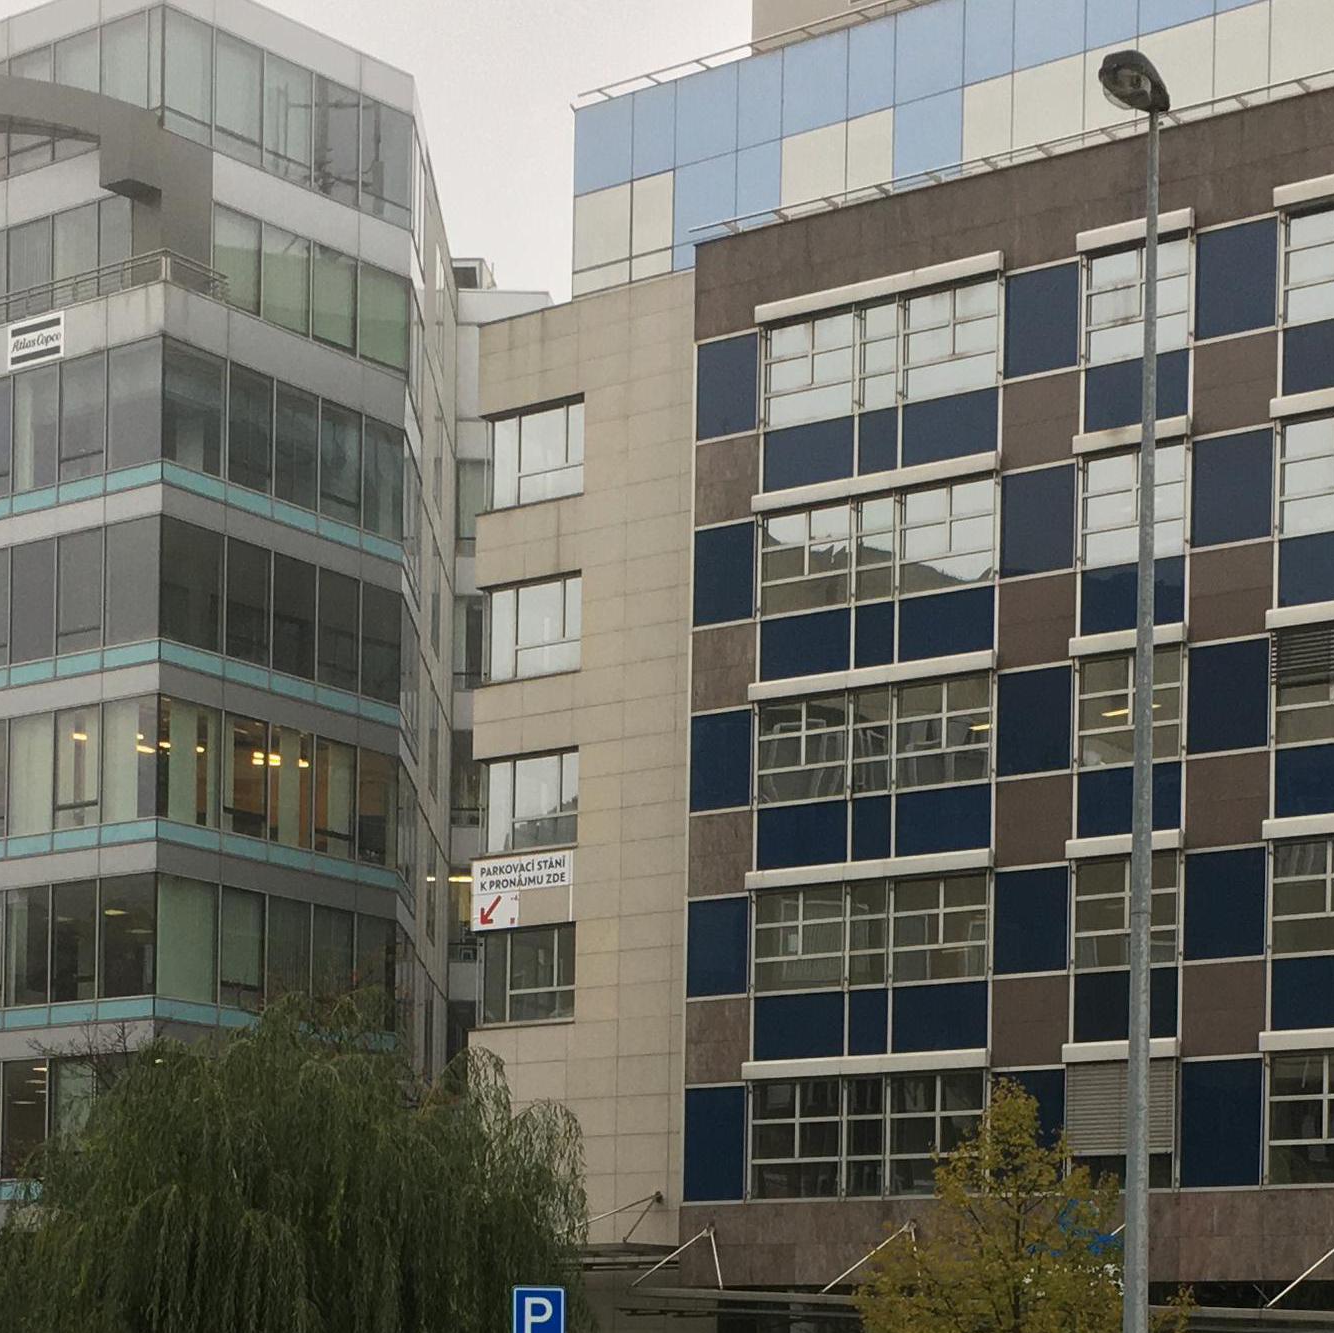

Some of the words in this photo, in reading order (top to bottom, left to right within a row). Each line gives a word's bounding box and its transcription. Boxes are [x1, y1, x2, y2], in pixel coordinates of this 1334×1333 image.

[12, 338, 36, 352] Atlas
[37, 332, 61, 346] Copco
[480, 859, 534, 877] PARKOVACÍ
[537, 855, 566, 871] STÁNÍ
[480, 881, 487, 891] K
[489, 874, 543, 890] PRONÁJMU
[546, 872, 565, 884] ZDE
